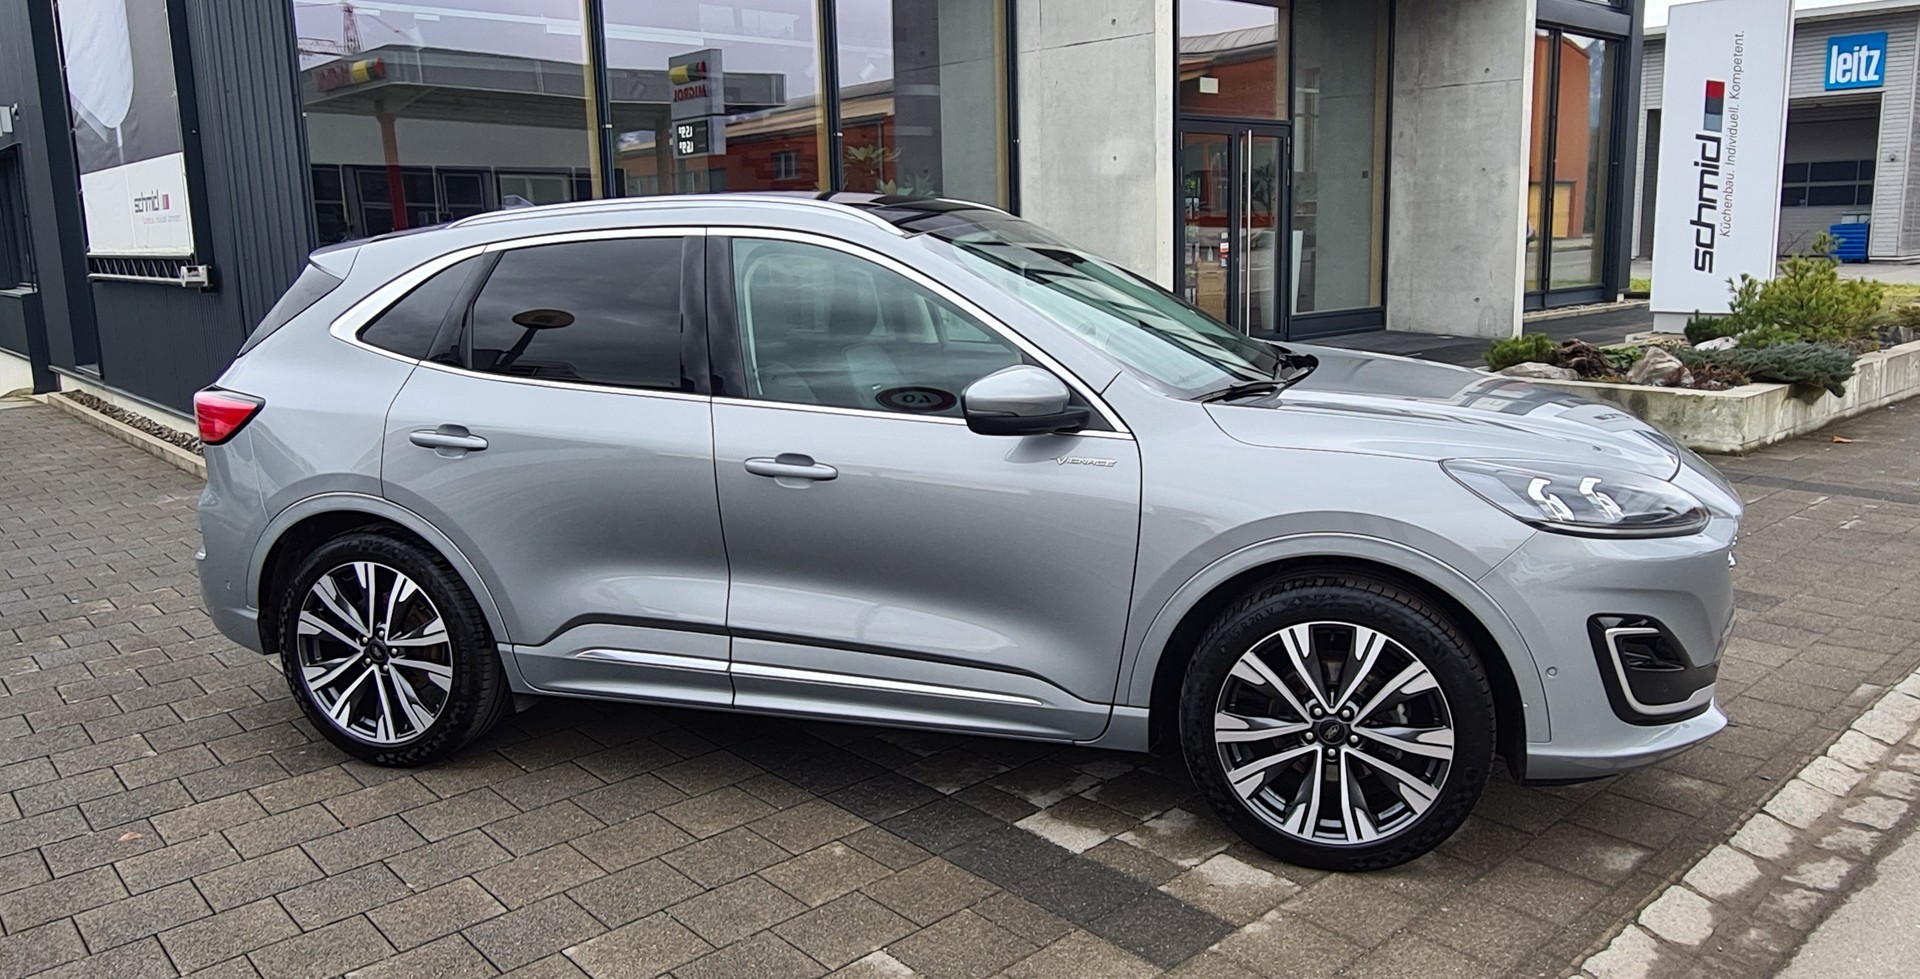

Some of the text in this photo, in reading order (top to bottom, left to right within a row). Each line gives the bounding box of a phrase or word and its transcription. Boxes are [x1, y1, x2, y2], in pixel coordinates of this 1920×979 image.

[1829, 45, 1881, 84] leitz
[1720, 31, 1745, 238] Küchenbau. Individuell. Kompetent.
[134, 189, 159, 213] schmid
[1690, 134, 1722, 274] schmid
